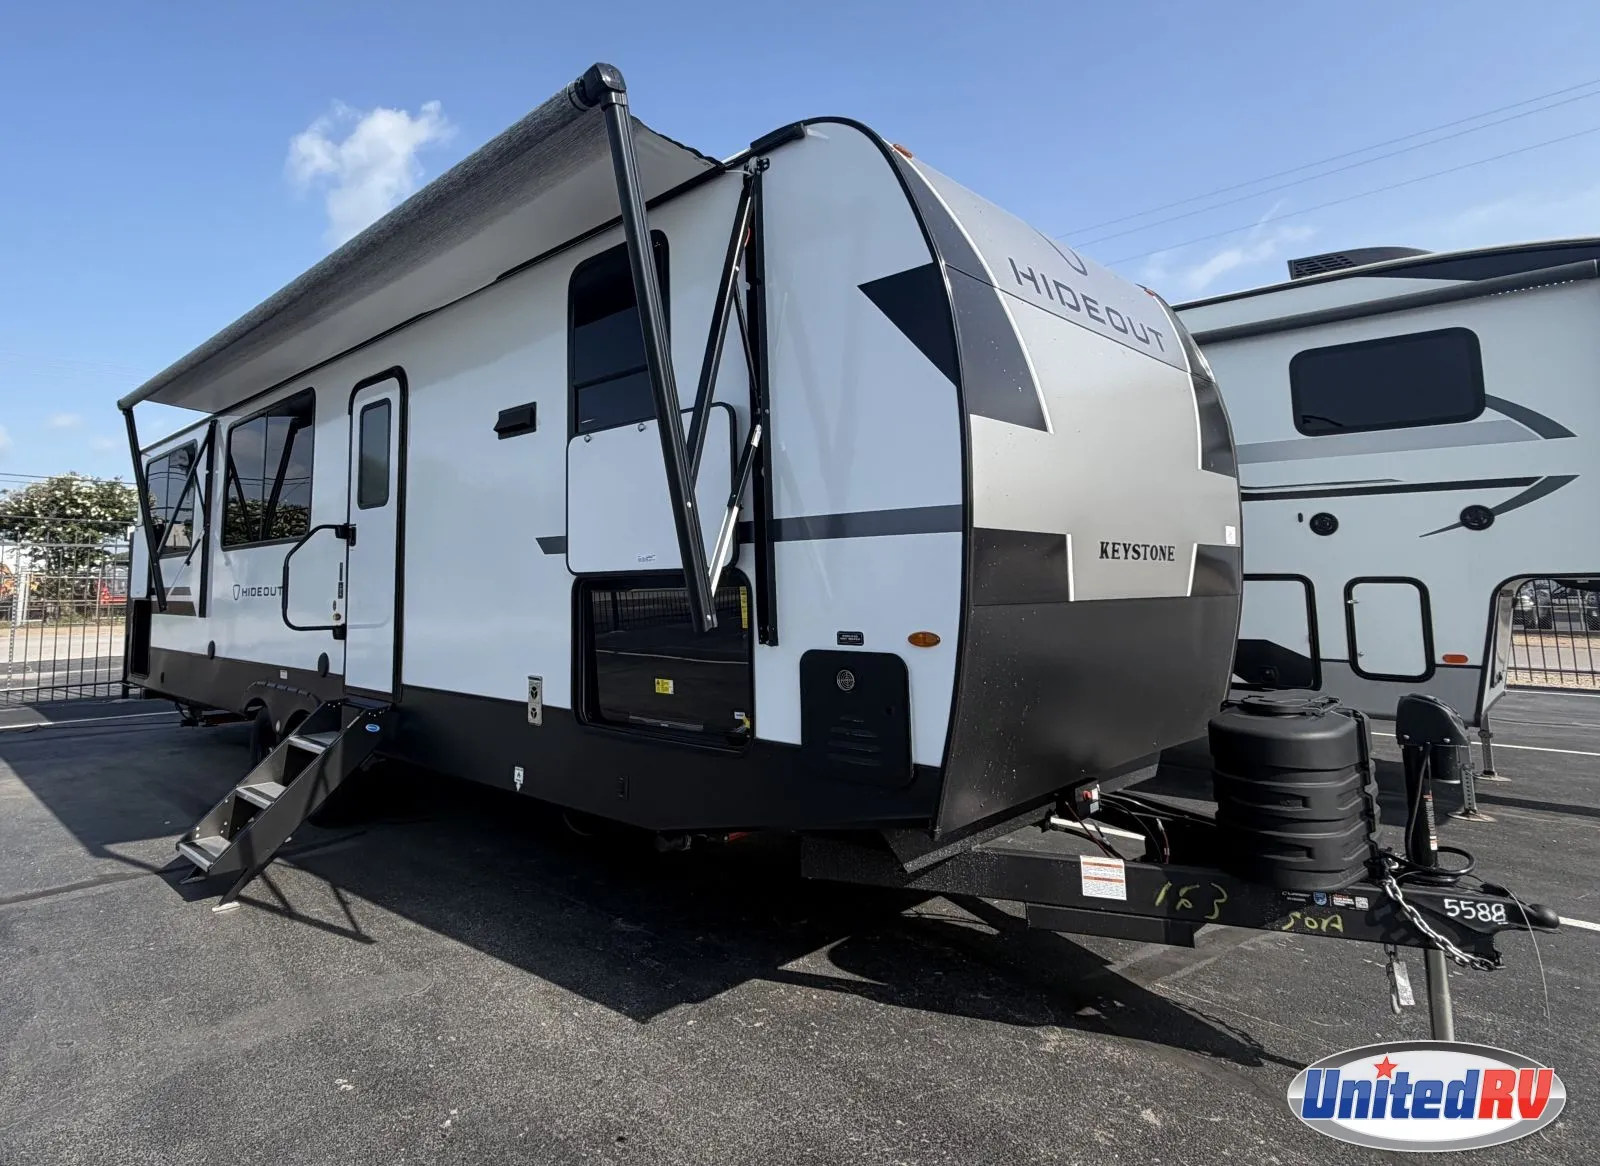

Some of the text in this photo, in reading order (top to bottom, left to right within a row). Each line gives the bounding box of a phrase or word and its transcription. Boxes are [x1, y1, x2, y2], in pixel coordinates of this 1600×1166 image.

[1008, 256, 1165, 352] HIDEOUT
[1098, 541, 1176, 562] KEYSTONE
[241, 586, 283, 597] HIDEOUT
[1443, 898, 1507, 922] 5588
